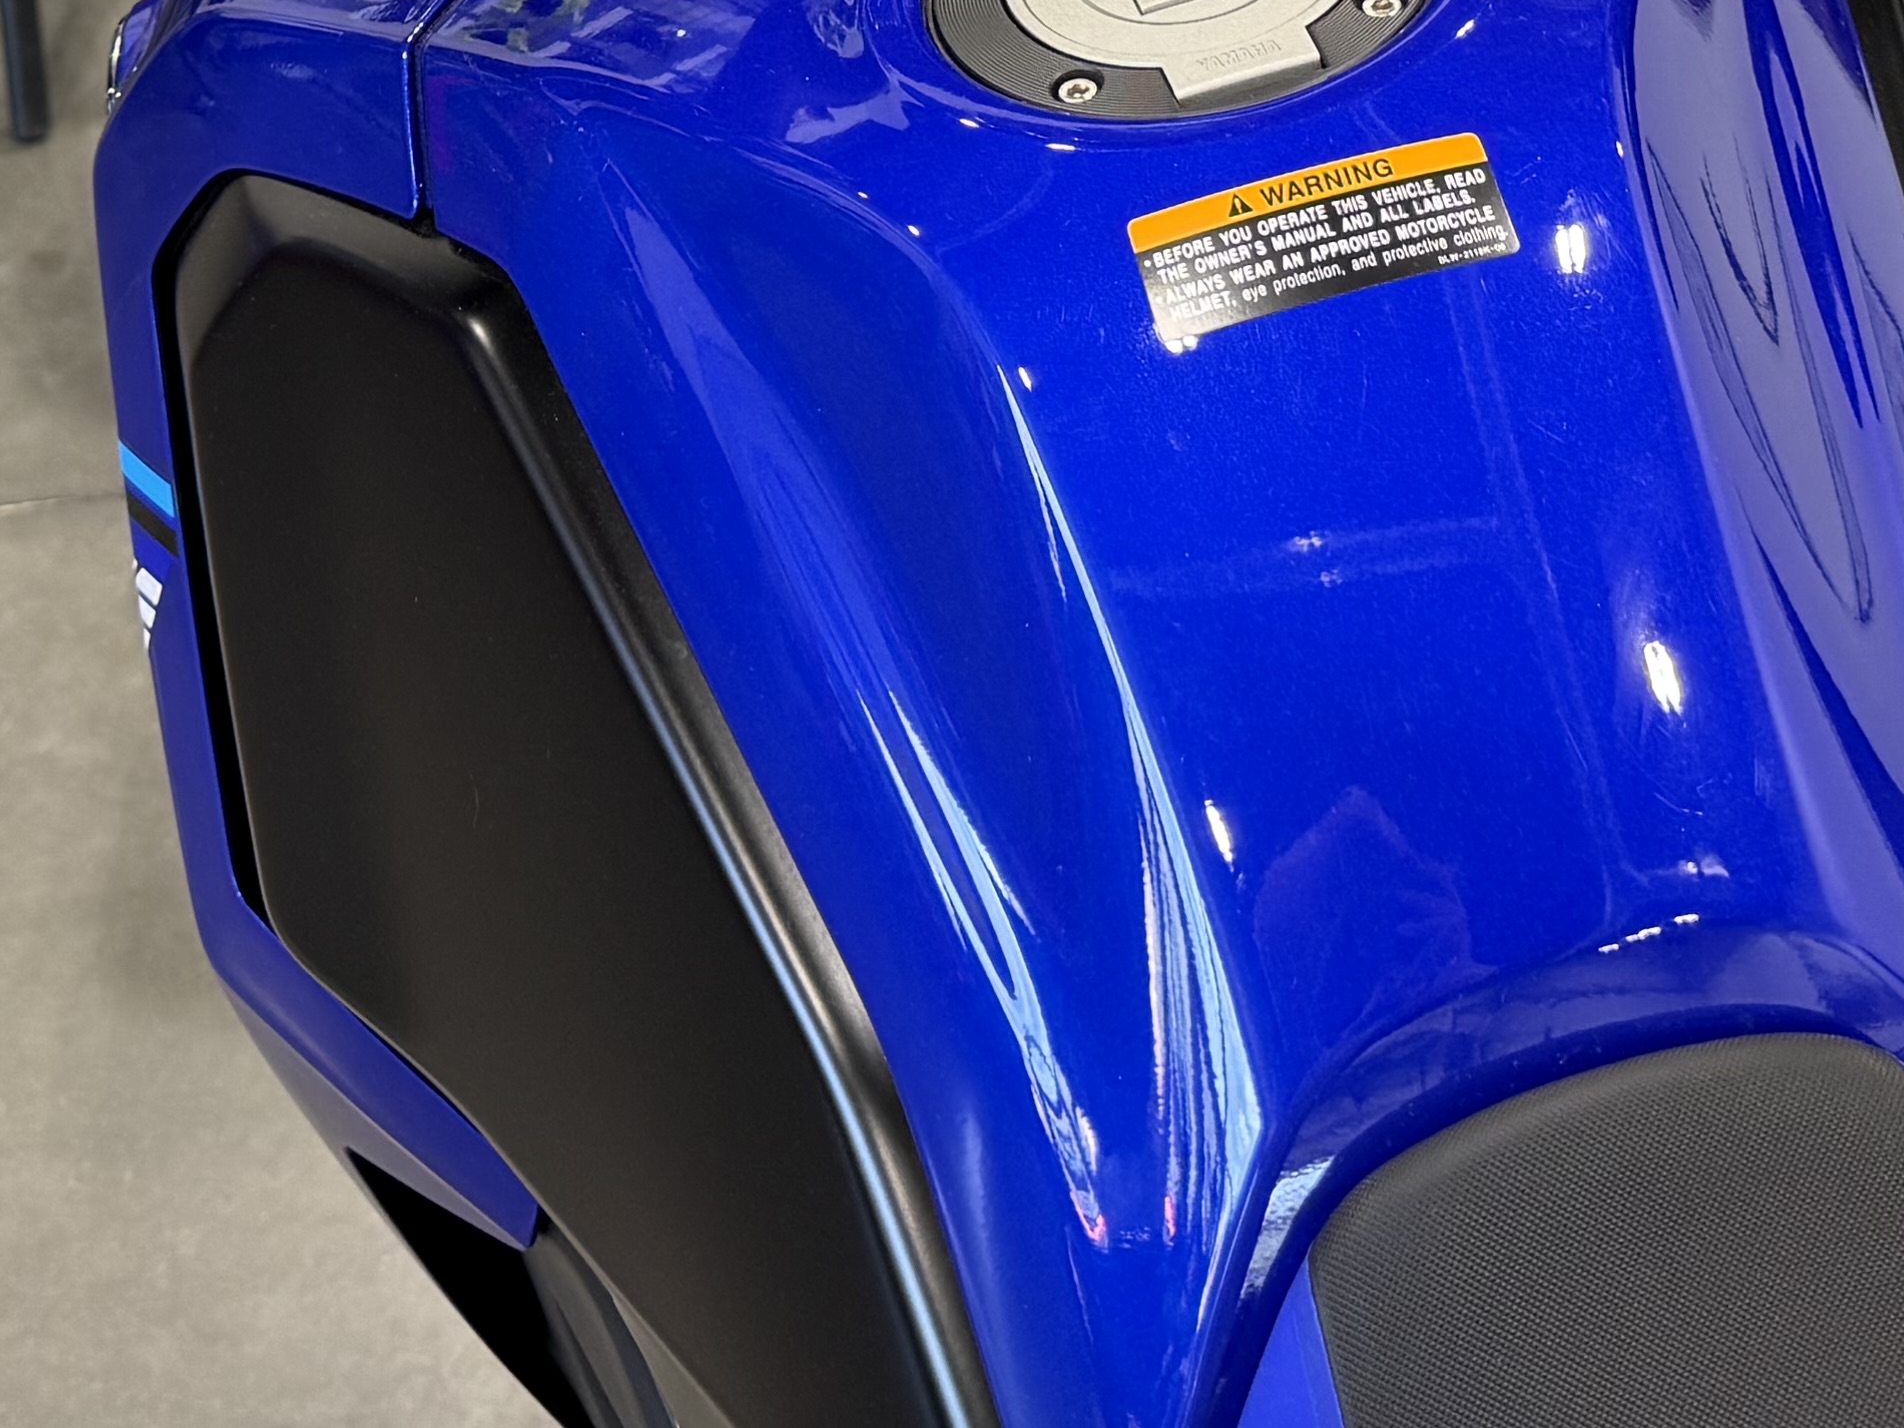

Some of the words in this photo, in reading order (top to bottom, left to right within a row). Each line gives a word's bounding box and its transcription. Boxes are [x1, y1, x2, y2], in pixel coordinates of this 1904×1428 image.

[1196, 39, 1282, 71] YAMAHA
[1153, 237, 1215, 268] BEFORE
[1219, 225, 1252, 246] YOU
[1257, 205, 1327, 236] OPERATE
[1332, 195, 1368, 216] THIS
[1444, 168, 1485, 191] READ
[1260, 159, 1393, 207] WARNING
[1157, 263, 1189, 284] THE
[1195, 241, 1267, 273] OWNER'S
[1271, 223, 1336, 252] MANUAL
[1342, 211, 1373, 233] AND
[1380, 207, 1409, 224] ALL
[1413, 190, 1475, 215] LABELS.
[1166, 273, 1225, 305] ALWAYS
[1229, 260, 1276, 285] WEAR
[1282, 252, 1304, 270] AN
[1311, 229, 1390, 263] APPROVED
[1395, 205, 1495, 241] MOTORCYCLE
[1242, 284, 1267, 302] eye
[1351, 250, 1378, 271] and
[1382, 235, 1448, 266] protective
[1453, 225, 1508, 246] clothing.
